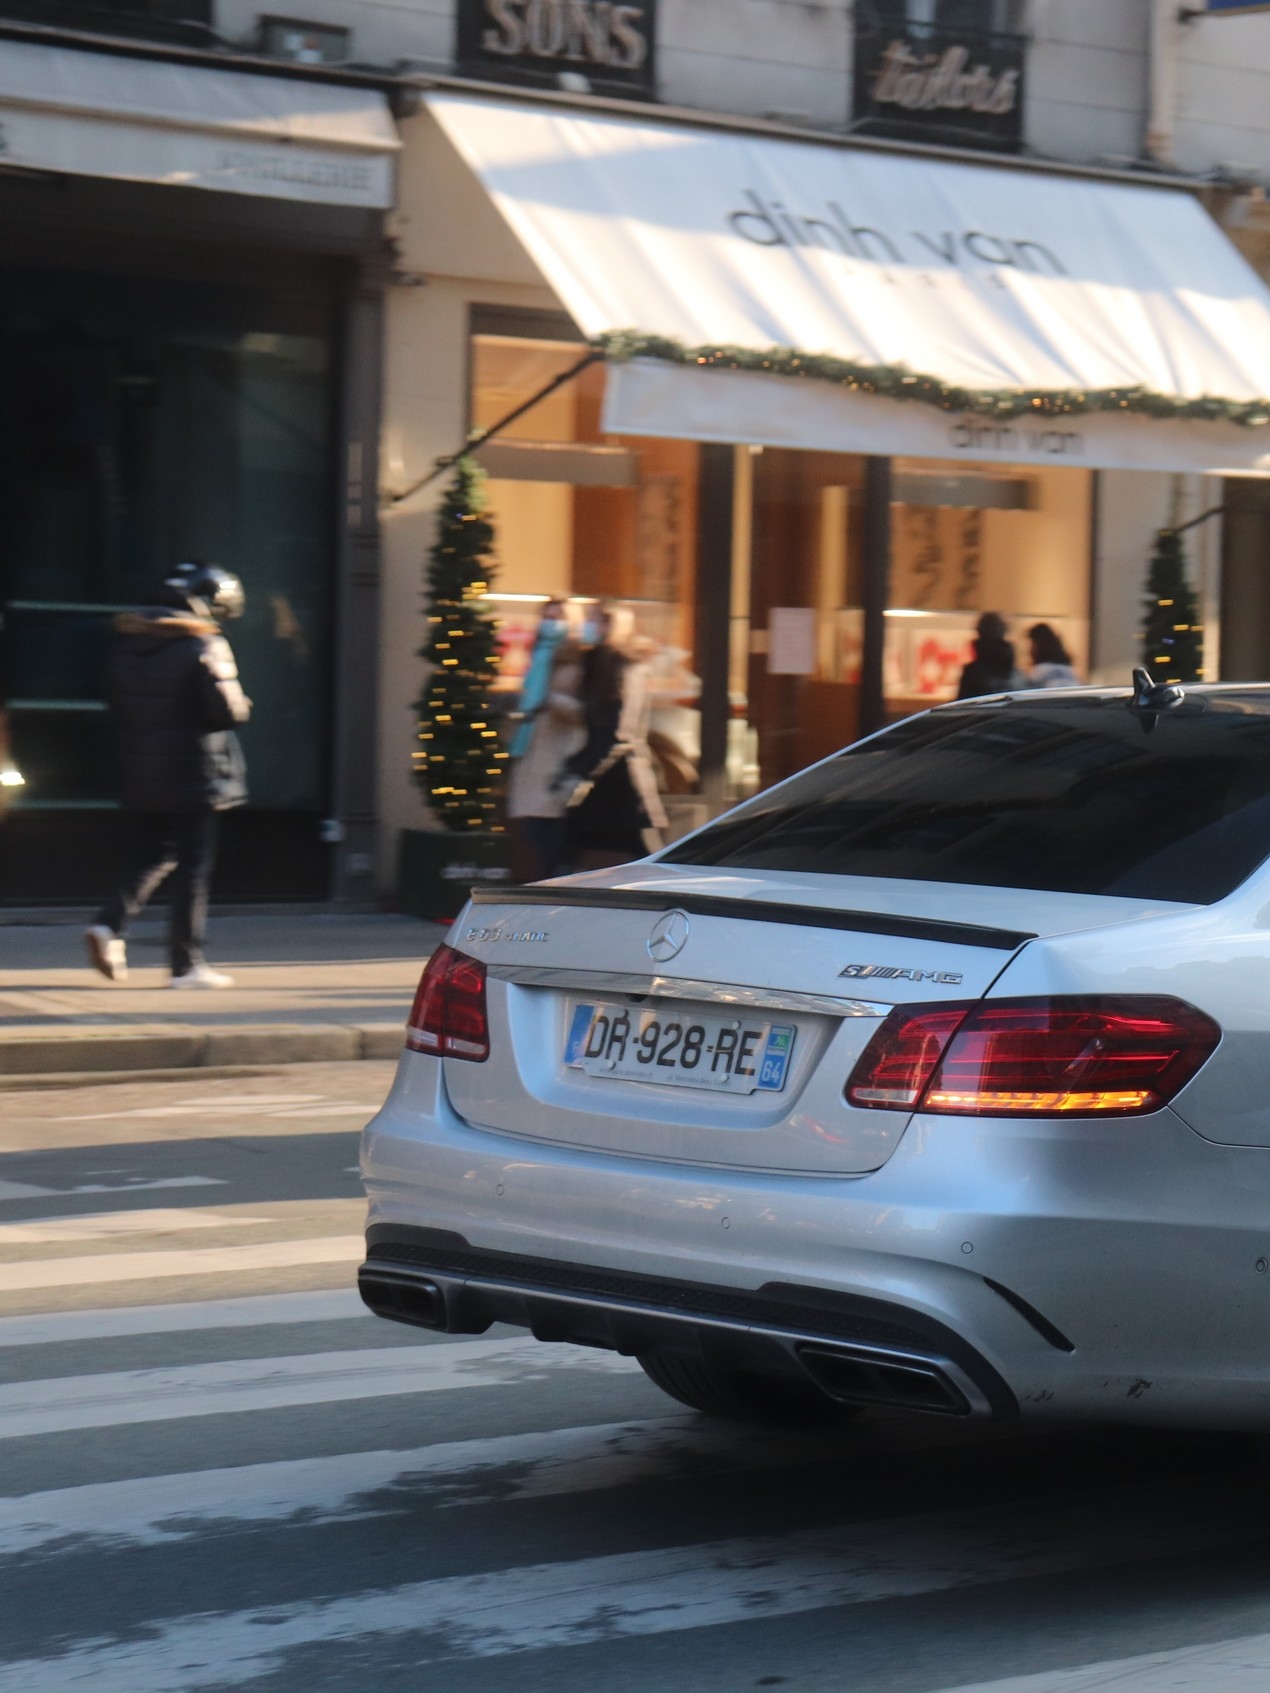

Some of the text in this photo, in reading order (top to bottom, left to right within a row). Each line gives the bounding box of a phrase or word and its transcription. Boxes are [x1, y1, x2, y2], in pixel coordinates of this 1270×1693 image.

[483, 0, 648, 69] SONS
[726, 188, 1070, 276] dinh van
[466, 928, 476, 942] E
[479, 928, 502, 942] 63
[761, 1060, 782, 1083] 64
